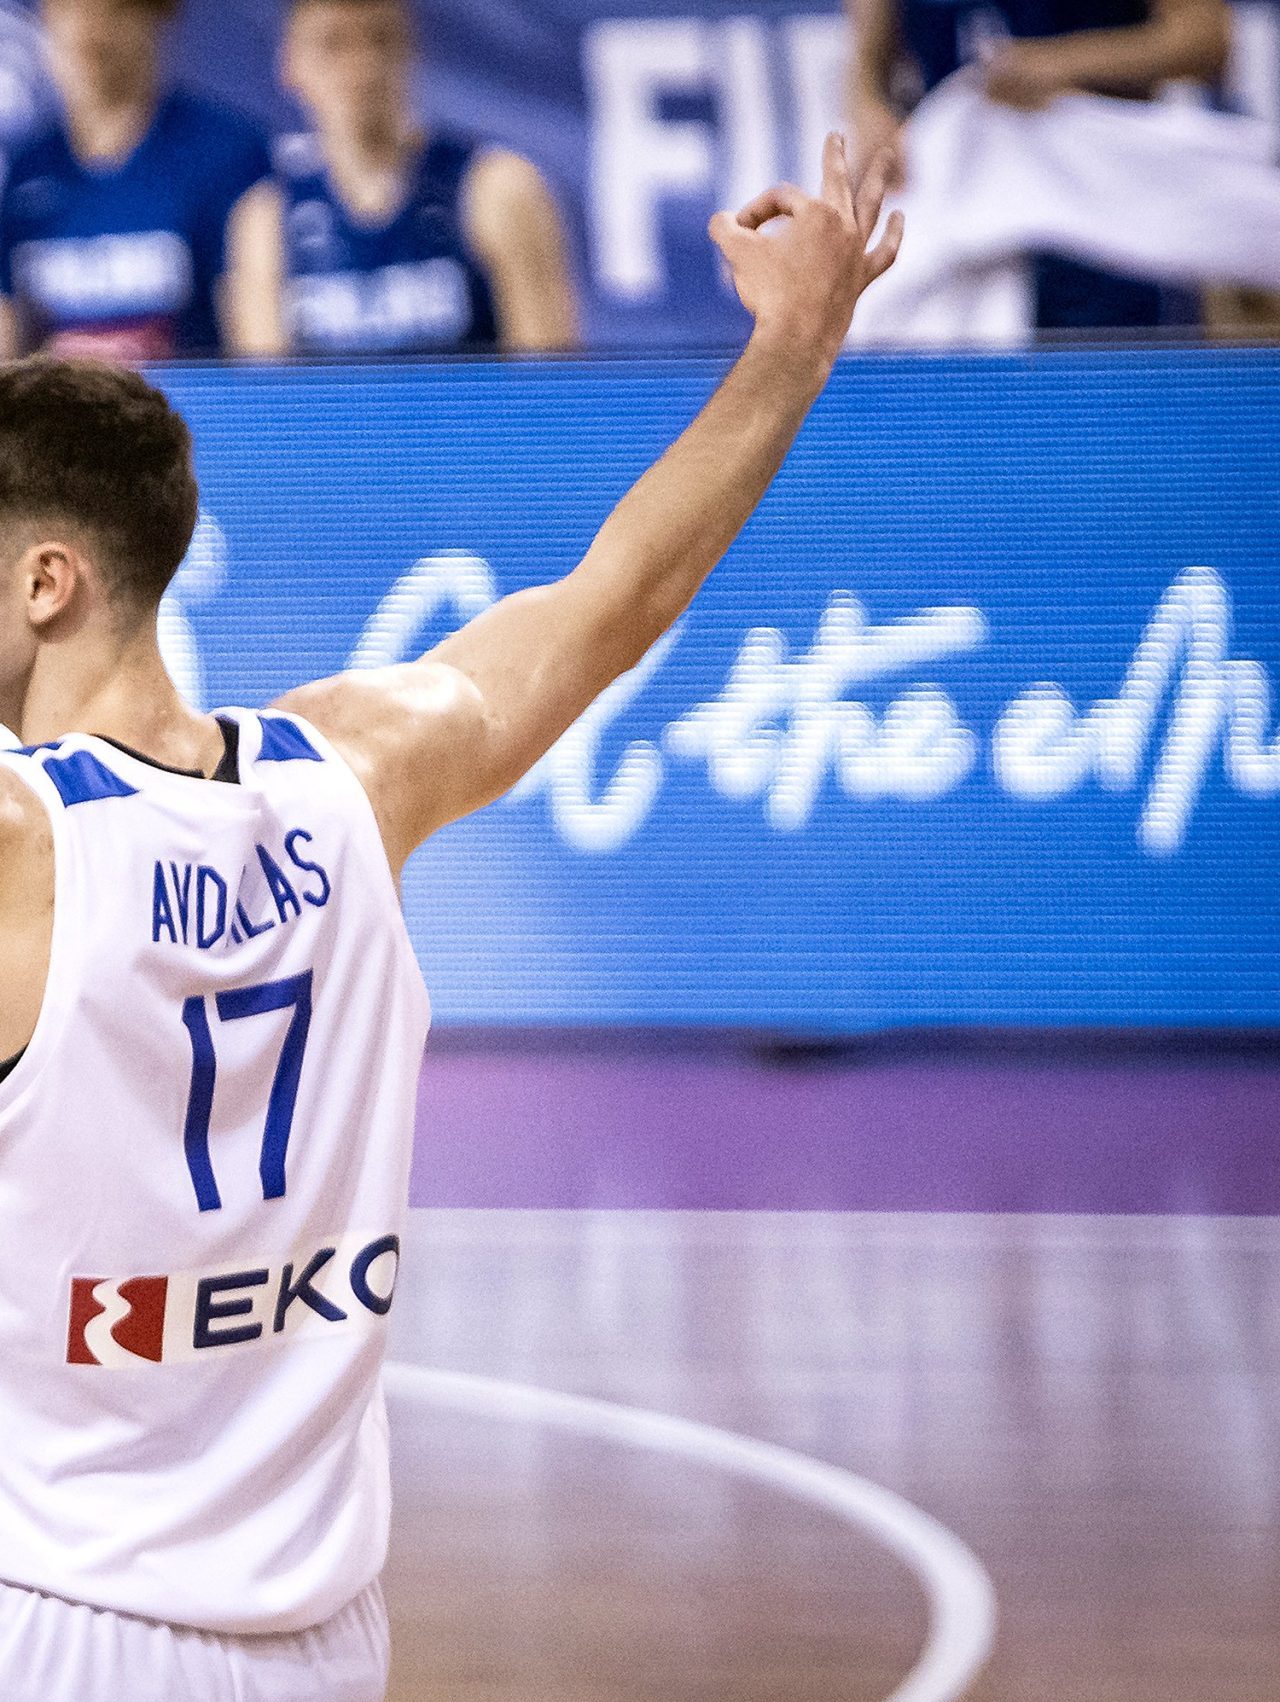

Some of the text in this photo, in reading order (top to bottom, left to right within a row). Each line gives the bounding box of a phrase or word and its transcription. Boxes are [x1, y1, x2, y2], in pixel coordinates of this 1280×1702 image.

[152, 828, 331, 950] AVDLAS
[182, 968, 314, 1212] 17
[192, 1232, 400, 1349] EKO
